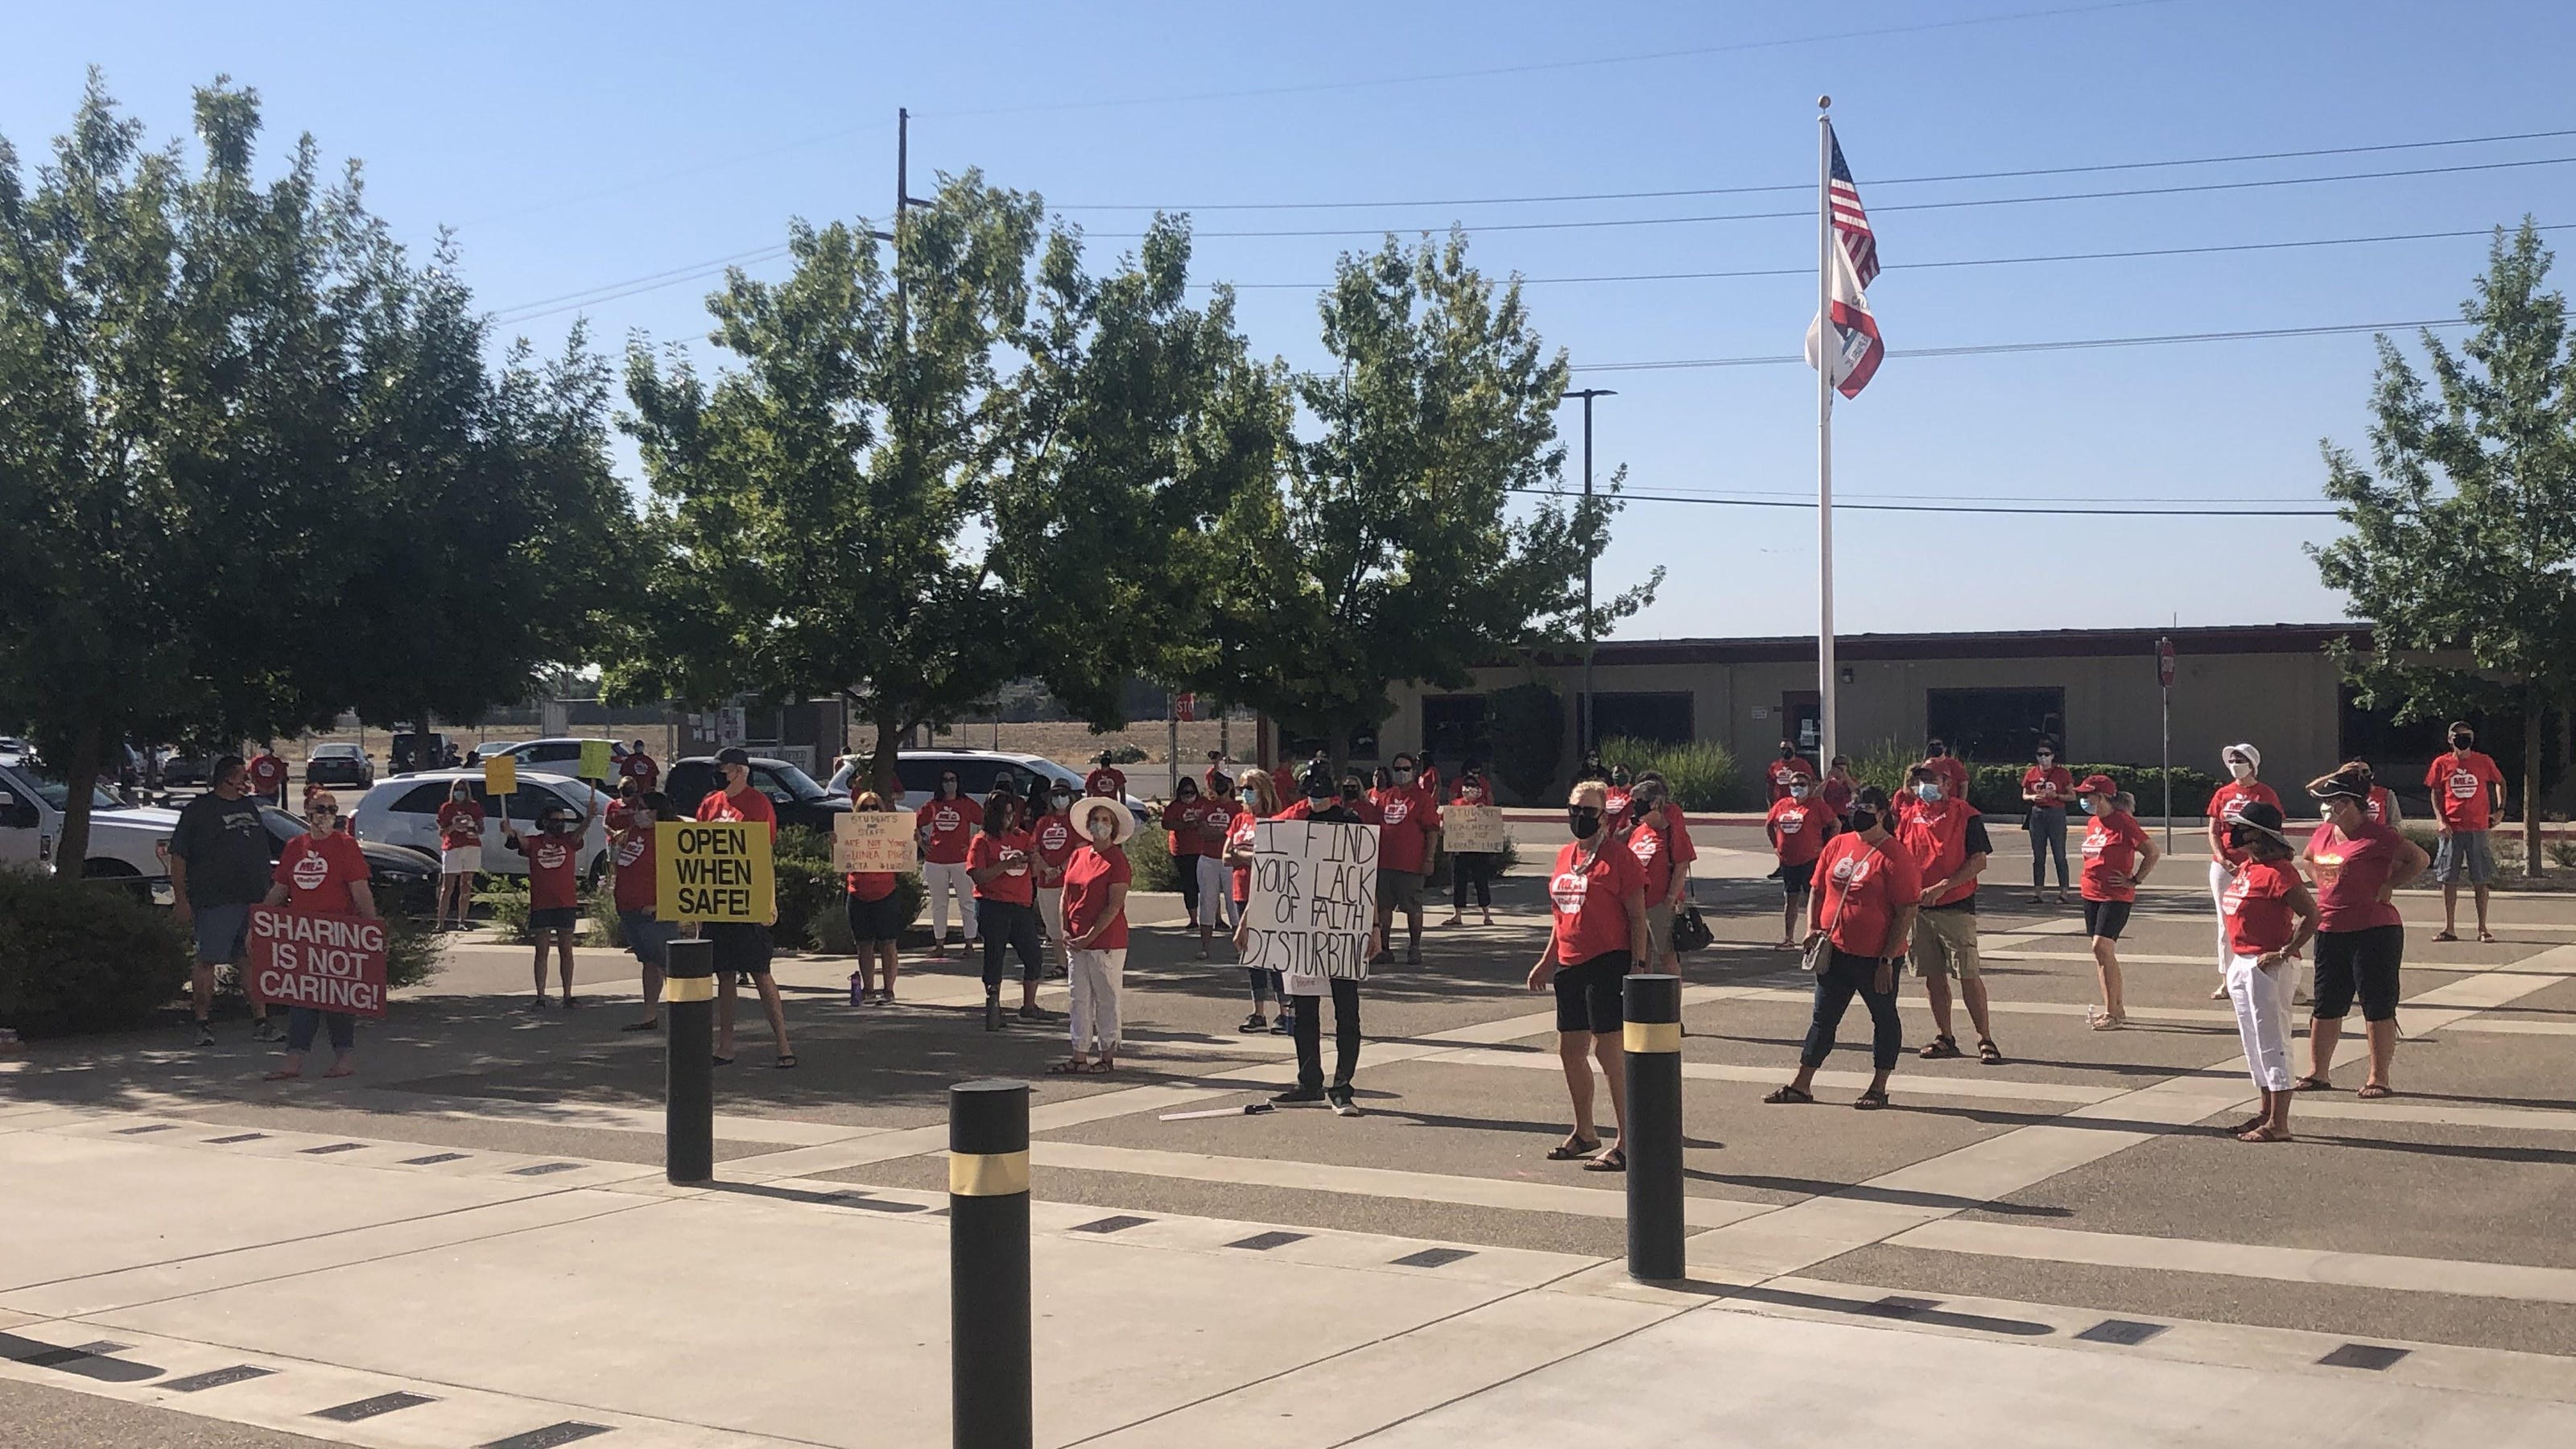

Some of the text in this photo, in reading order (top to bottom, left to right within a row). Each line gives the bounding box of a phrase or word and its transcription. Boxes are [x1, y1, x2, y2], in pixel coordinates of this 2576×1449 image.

[850, 815, 898, 824] STUDENTS
[857, 828, 886, 836] STAFF
[678, 828, 746, 855] OPEN
[868, 839, 882, 848] NOT
[1255, 821, 1377, 865] I FIND
[675, 858, 752, 885] WHEN
[1254, 857, 1376, 906] YOUR LACK
[678, 888, 749, 914] SAFE!
[1276, 894, 1364, 930] OF FAITH
[254, 911, 383, 952] SHARING
[272, 942, 369, 980] IS NOT
[1241, 927, 1372, 980] DISTURBING
[260, 971, 378, 1010] CARING!
